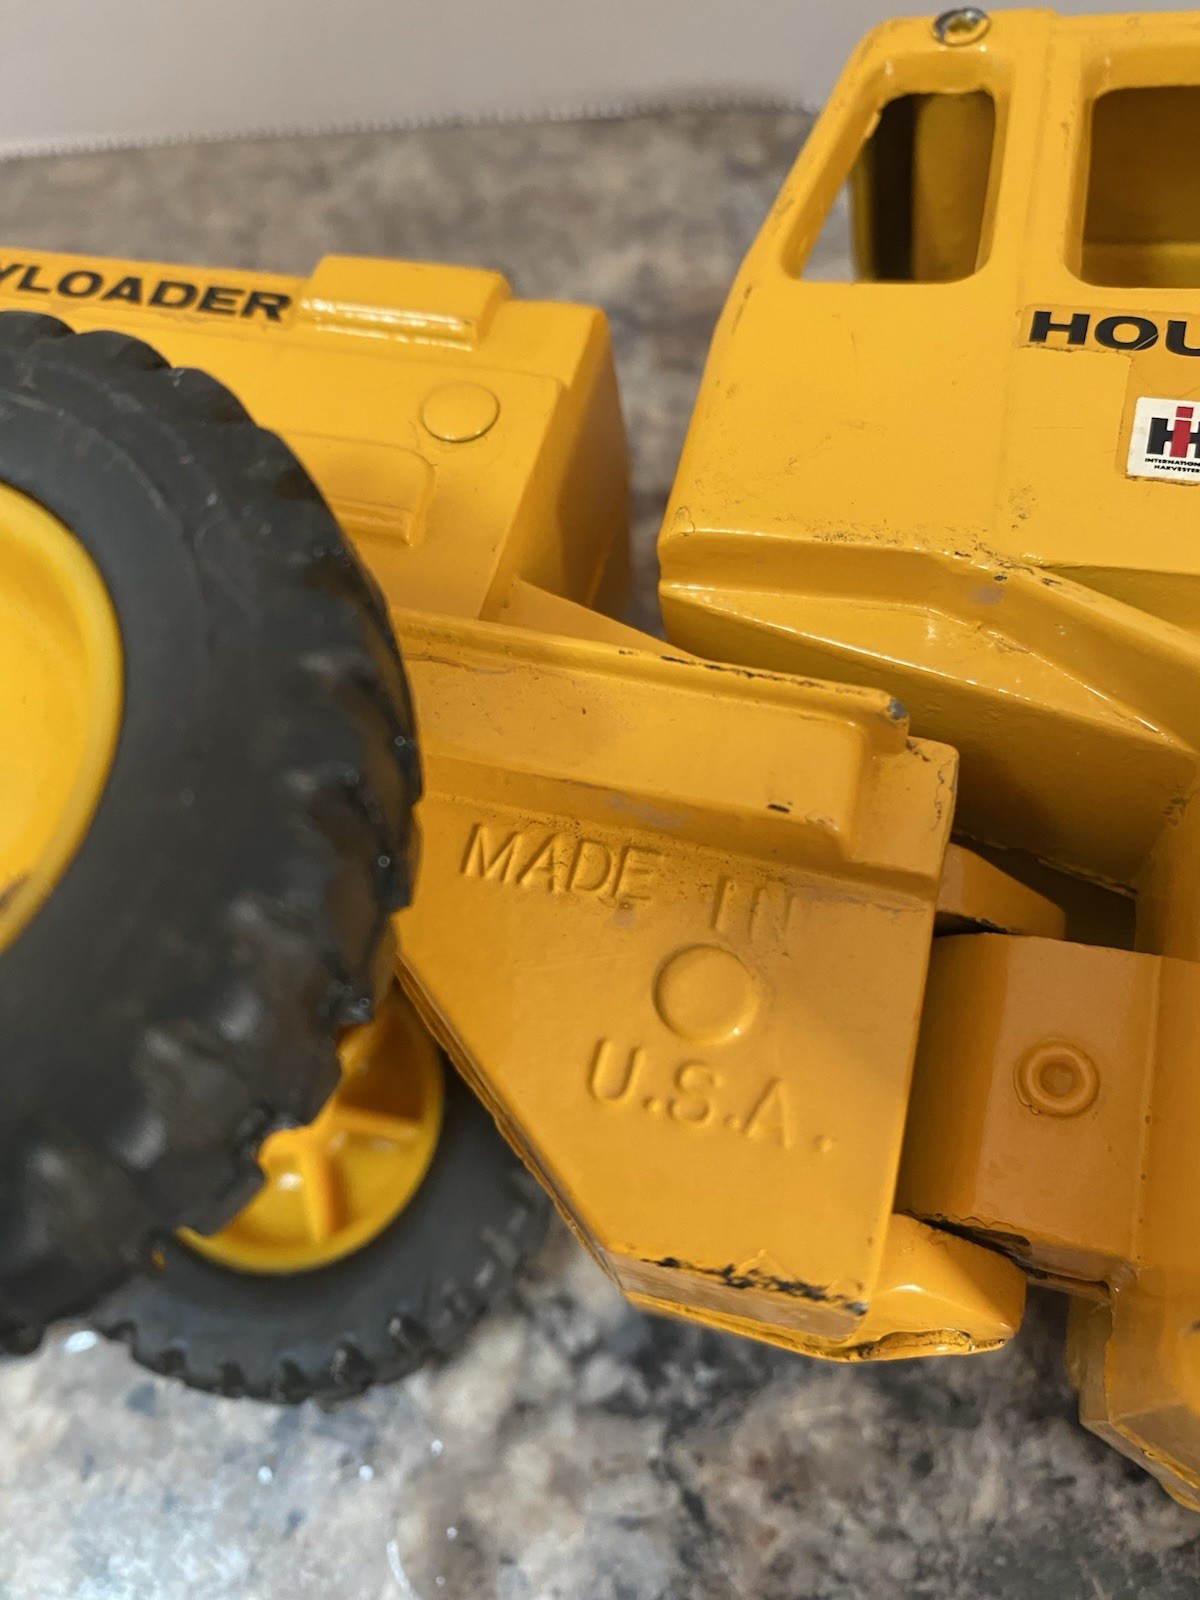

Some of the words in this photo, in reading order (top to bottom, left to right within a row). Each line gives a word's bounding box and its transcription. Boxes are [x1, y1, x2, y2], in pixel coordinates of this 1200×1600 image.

[1029, 311, 1200, 357] HOU
[460, 823, 663, 901] MADE
[710, 874, 797, 955] IN
[587, 1035, 837, 1152] U.S.A.
